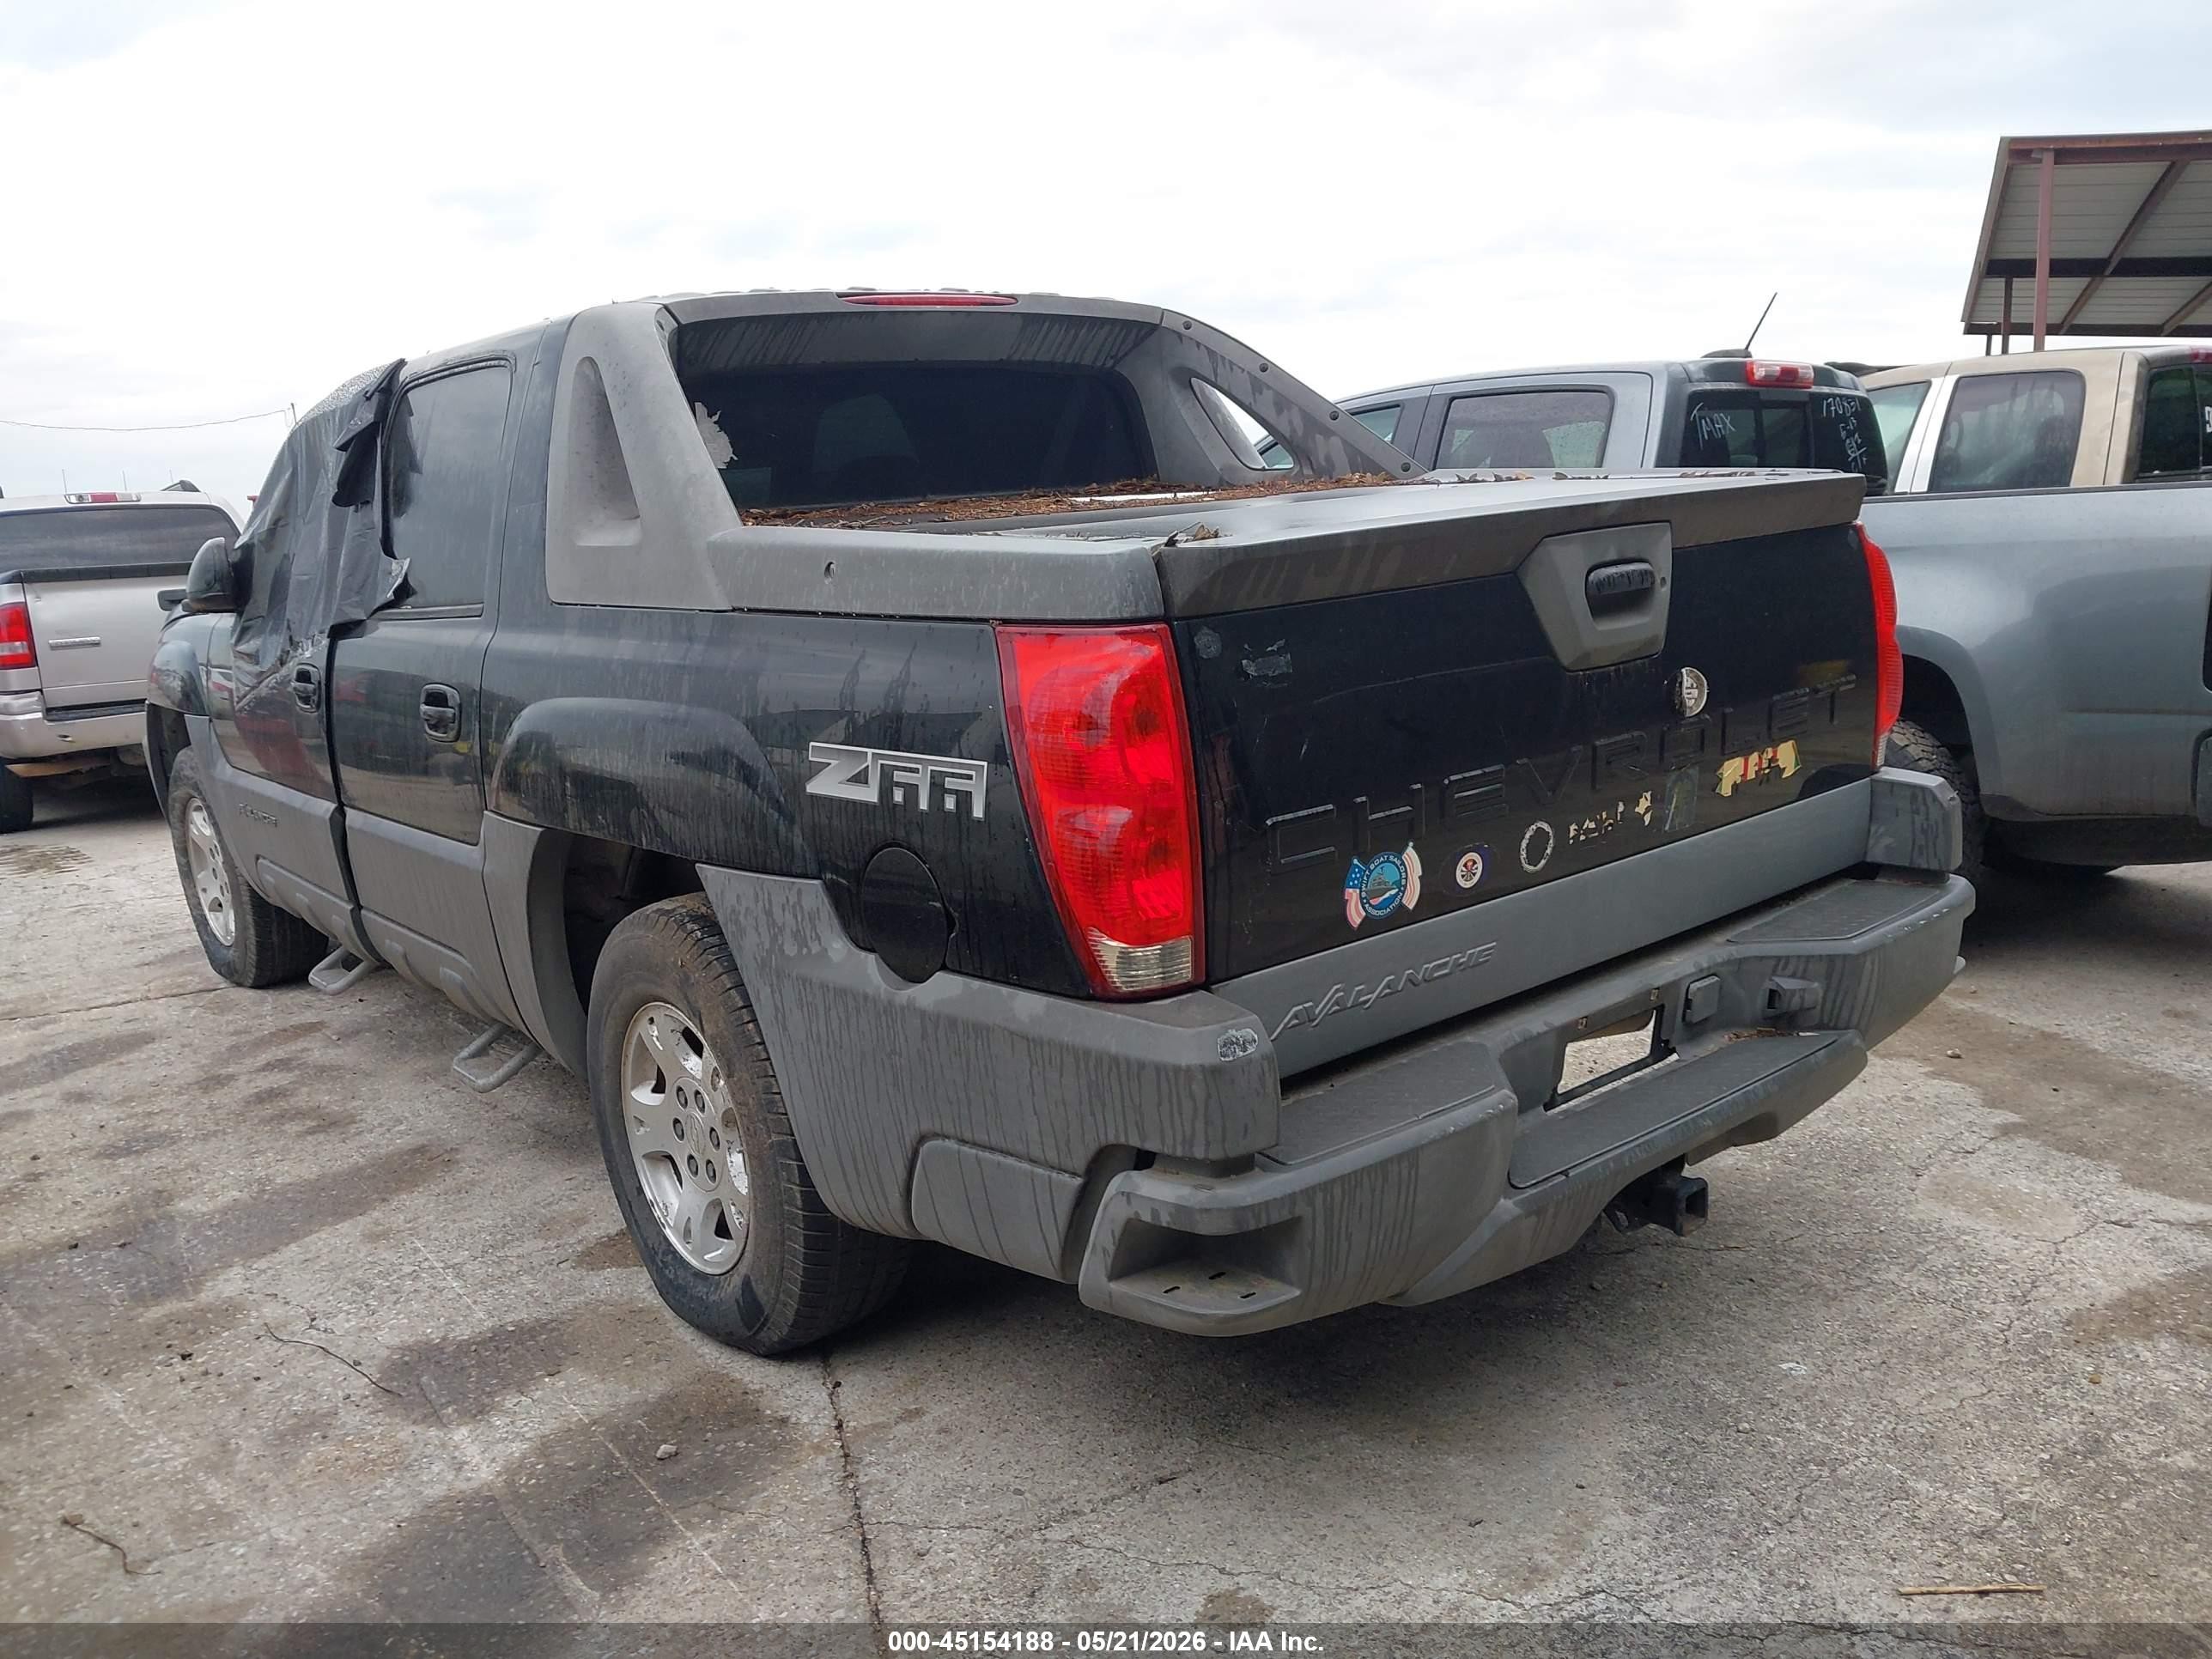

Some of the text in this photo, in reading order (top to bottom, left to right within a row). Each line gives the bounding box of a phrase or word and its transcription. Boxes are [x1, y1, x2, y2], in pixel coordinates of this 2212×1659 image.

[1264, 672, 1857, 874] CHEVROLET
[1360, 855, 1407, 898] SWIFT BOAT SAILORS
[1364, 892, 1404, 916] ASSOCIATION
[1269, 941, 1498, 1042] AVALANCHE
